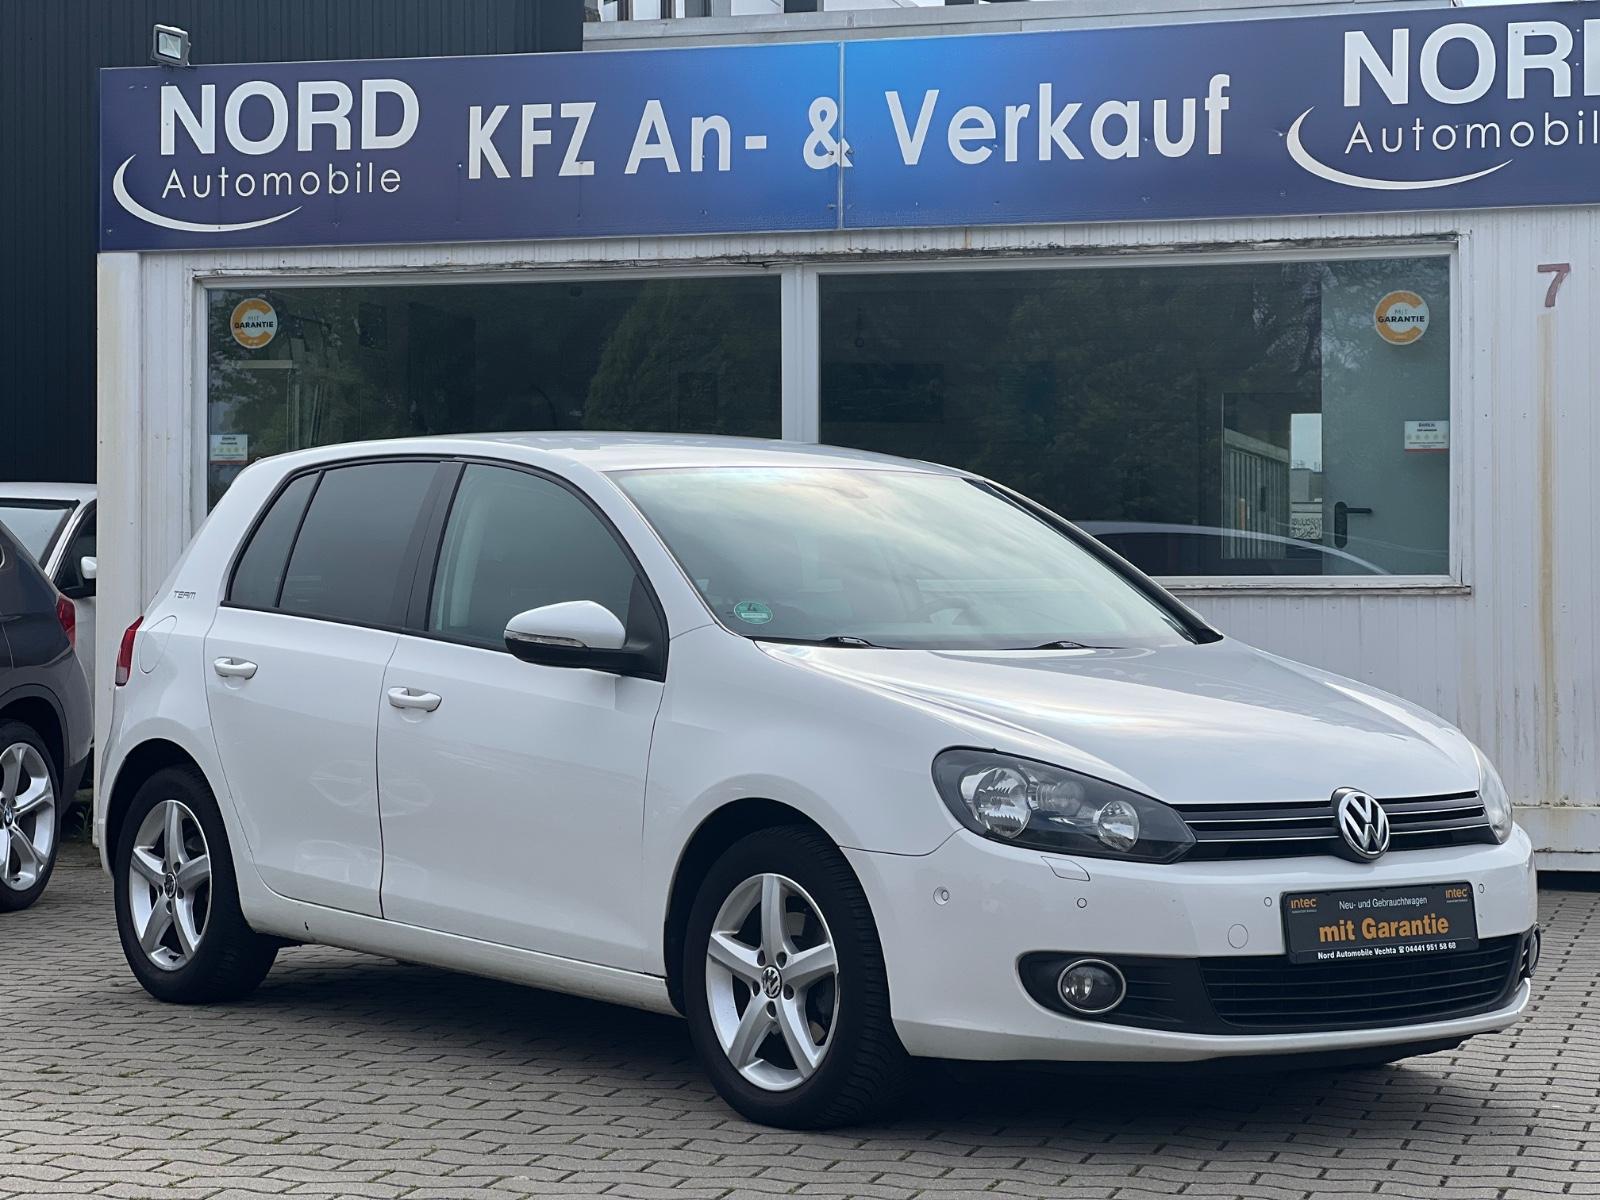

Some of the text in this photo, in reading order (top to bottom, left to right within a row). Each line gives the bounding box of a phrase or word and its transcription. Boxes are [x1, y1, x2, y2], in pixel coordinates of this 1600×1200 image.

[160, 79, 420, 156] NORD
[468, 74, 1231, 180] KFZ An- & Verkauf
[162, 162, 402, 199] Automobile
[1537, 263, 1570, 308] 7
[174, 590, 197, 599] TEAM
[1291, 898, 1317, 909] intec
[1339, 897, 1428, 910] Neu- und Gebrauchtwagen
[1319, 912, 1449, 942] mit Garantie
[1317, 951, 1335, 960] Nord
[1336, 948, 1373, 958] Automobile
[1374, 946, 1397, 955] Vechta
